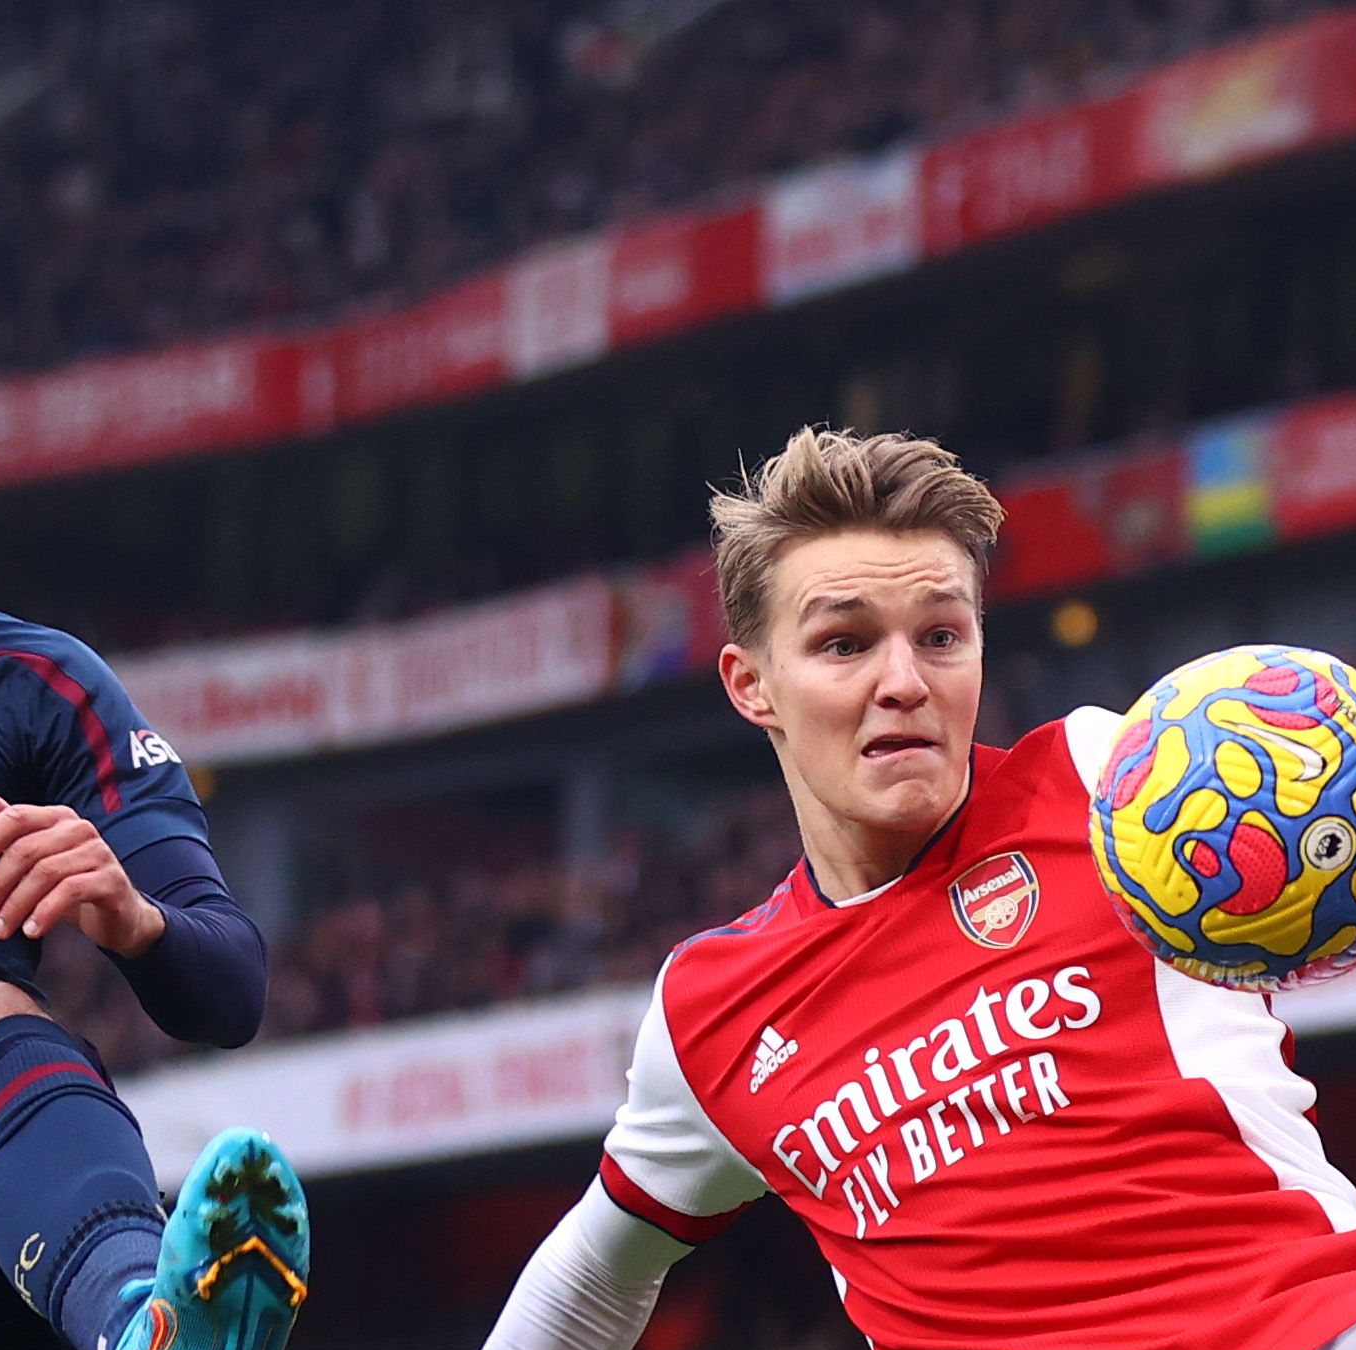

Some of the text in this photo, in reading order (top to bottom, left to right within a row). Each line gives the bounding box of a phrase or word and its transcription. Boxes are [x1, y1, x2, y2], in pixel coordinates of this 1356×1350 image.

[961, 864, 1022, 906] Arsenal
[749, 1038, 800, 1094] adidas
[772, 966, 1102, 1200] Emirates
[842, 1052, 1071, 1240] FLY BETTER
